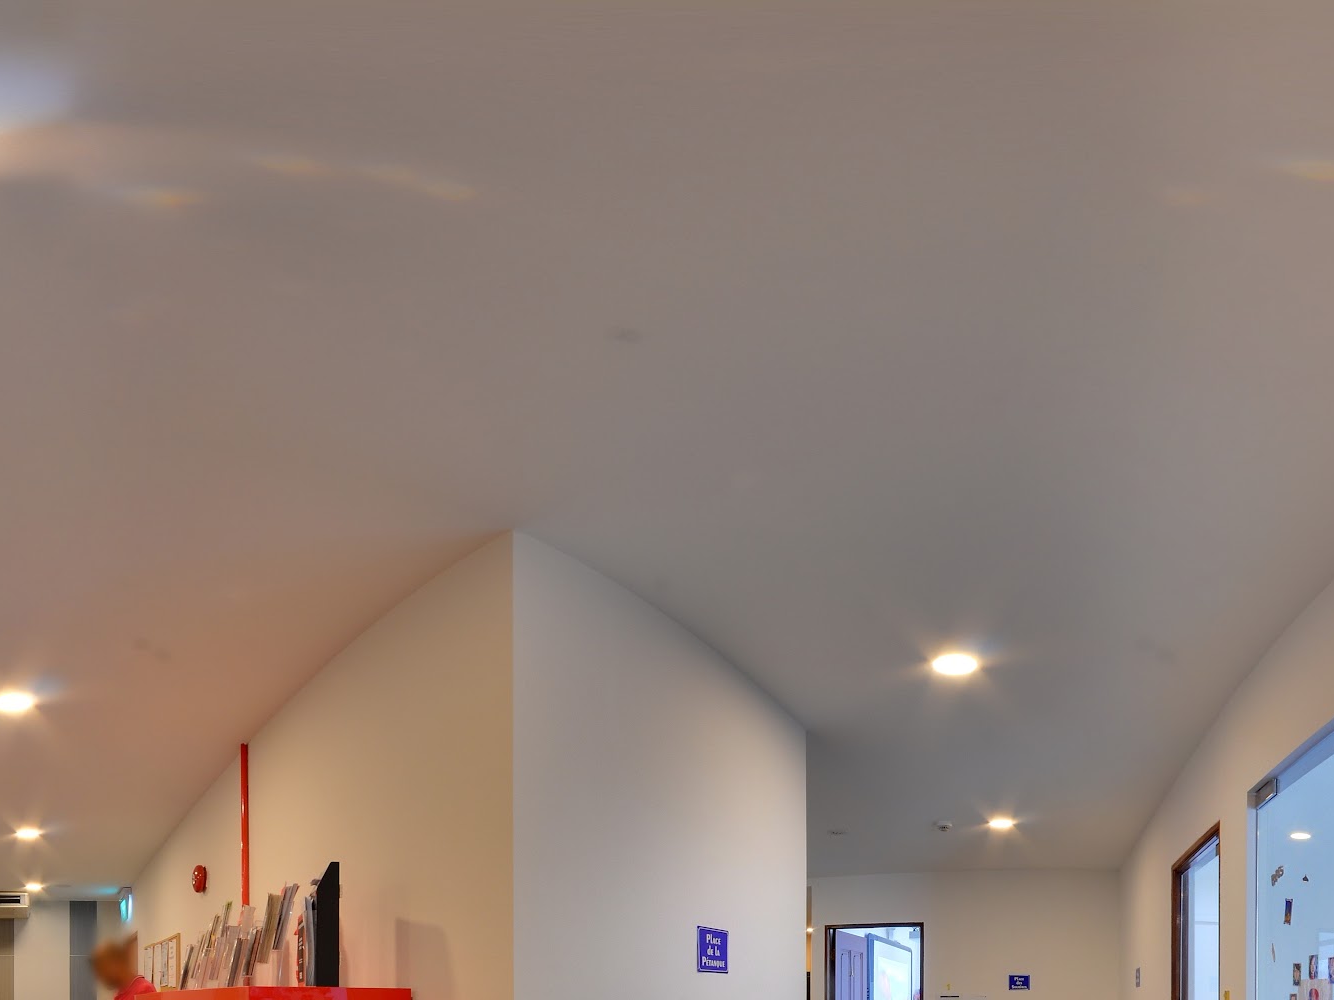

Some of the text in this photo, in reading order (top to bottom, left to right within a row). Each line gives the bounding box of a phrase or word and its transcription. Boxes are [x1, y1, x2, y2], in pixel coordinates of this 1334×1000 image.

[706, 933, 722, 945] Place
[707, 945, 714, 955] de
[702, 956, 725, 968] Pétanque
